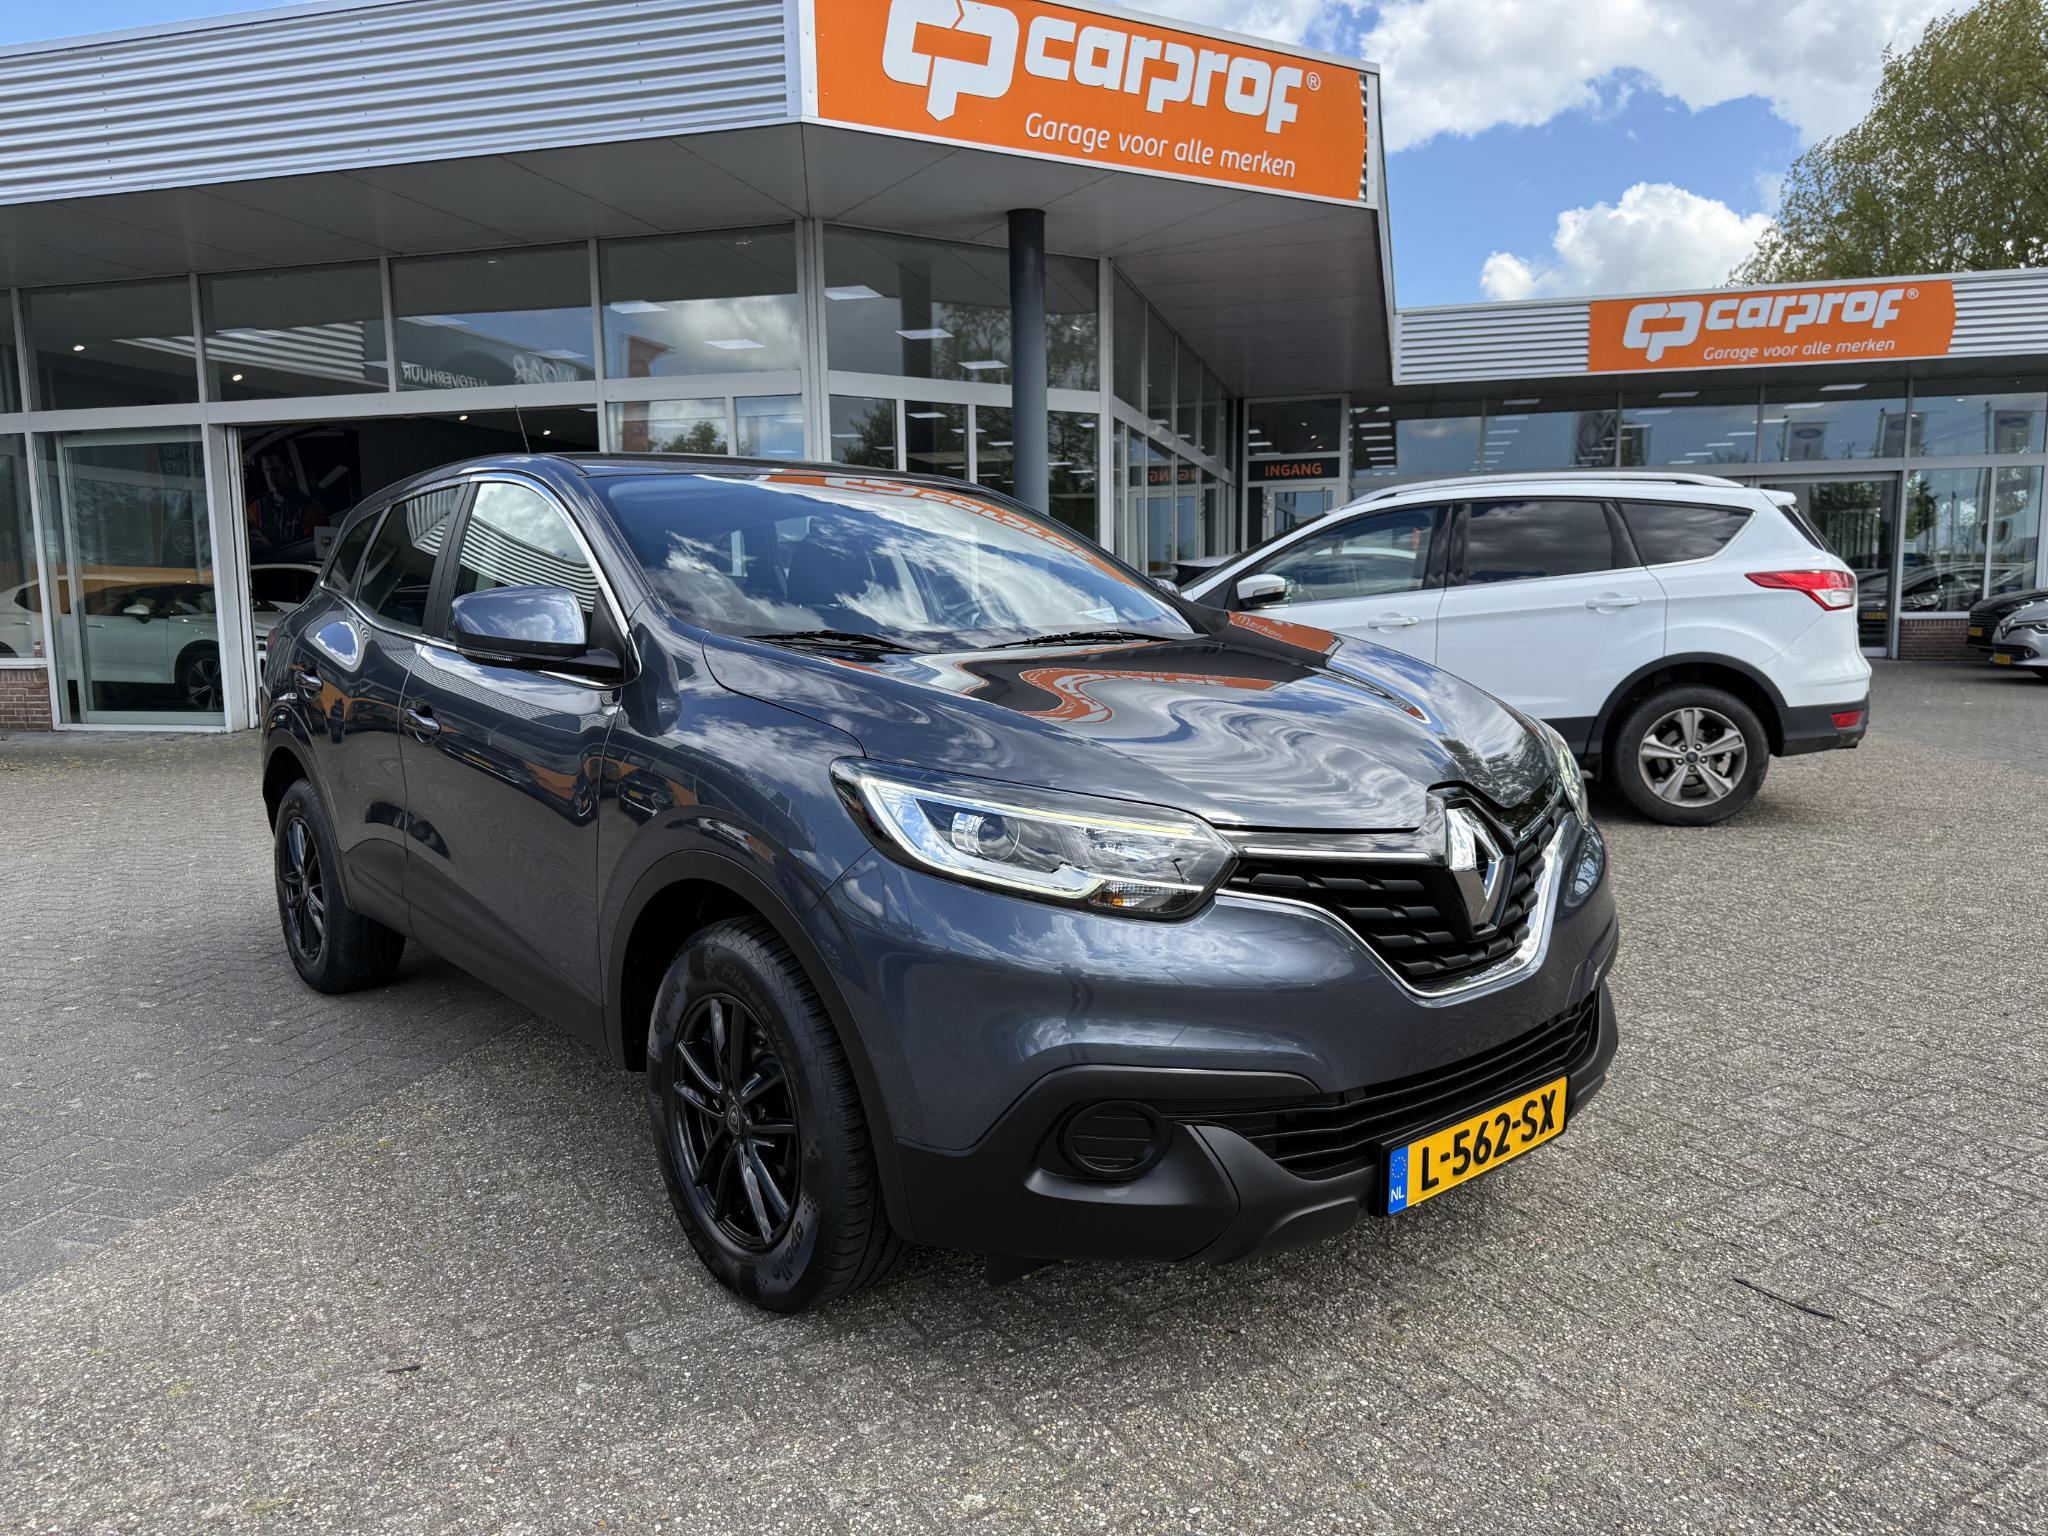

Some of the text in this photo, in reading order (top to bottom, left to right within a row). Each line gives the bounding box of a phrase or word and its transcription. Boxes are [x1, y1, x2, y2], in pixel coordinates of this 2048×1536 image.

[1025, 112, 1296, 178] Garage voor alle merken
[1703, 337, 1895, 361] Garage voor alle merken
[1265, 462, 1322, 477] INGANG
[1420, 1089, 1557, 1191] L-562-SX
[1390, 1186, 1404, 1203] NL
